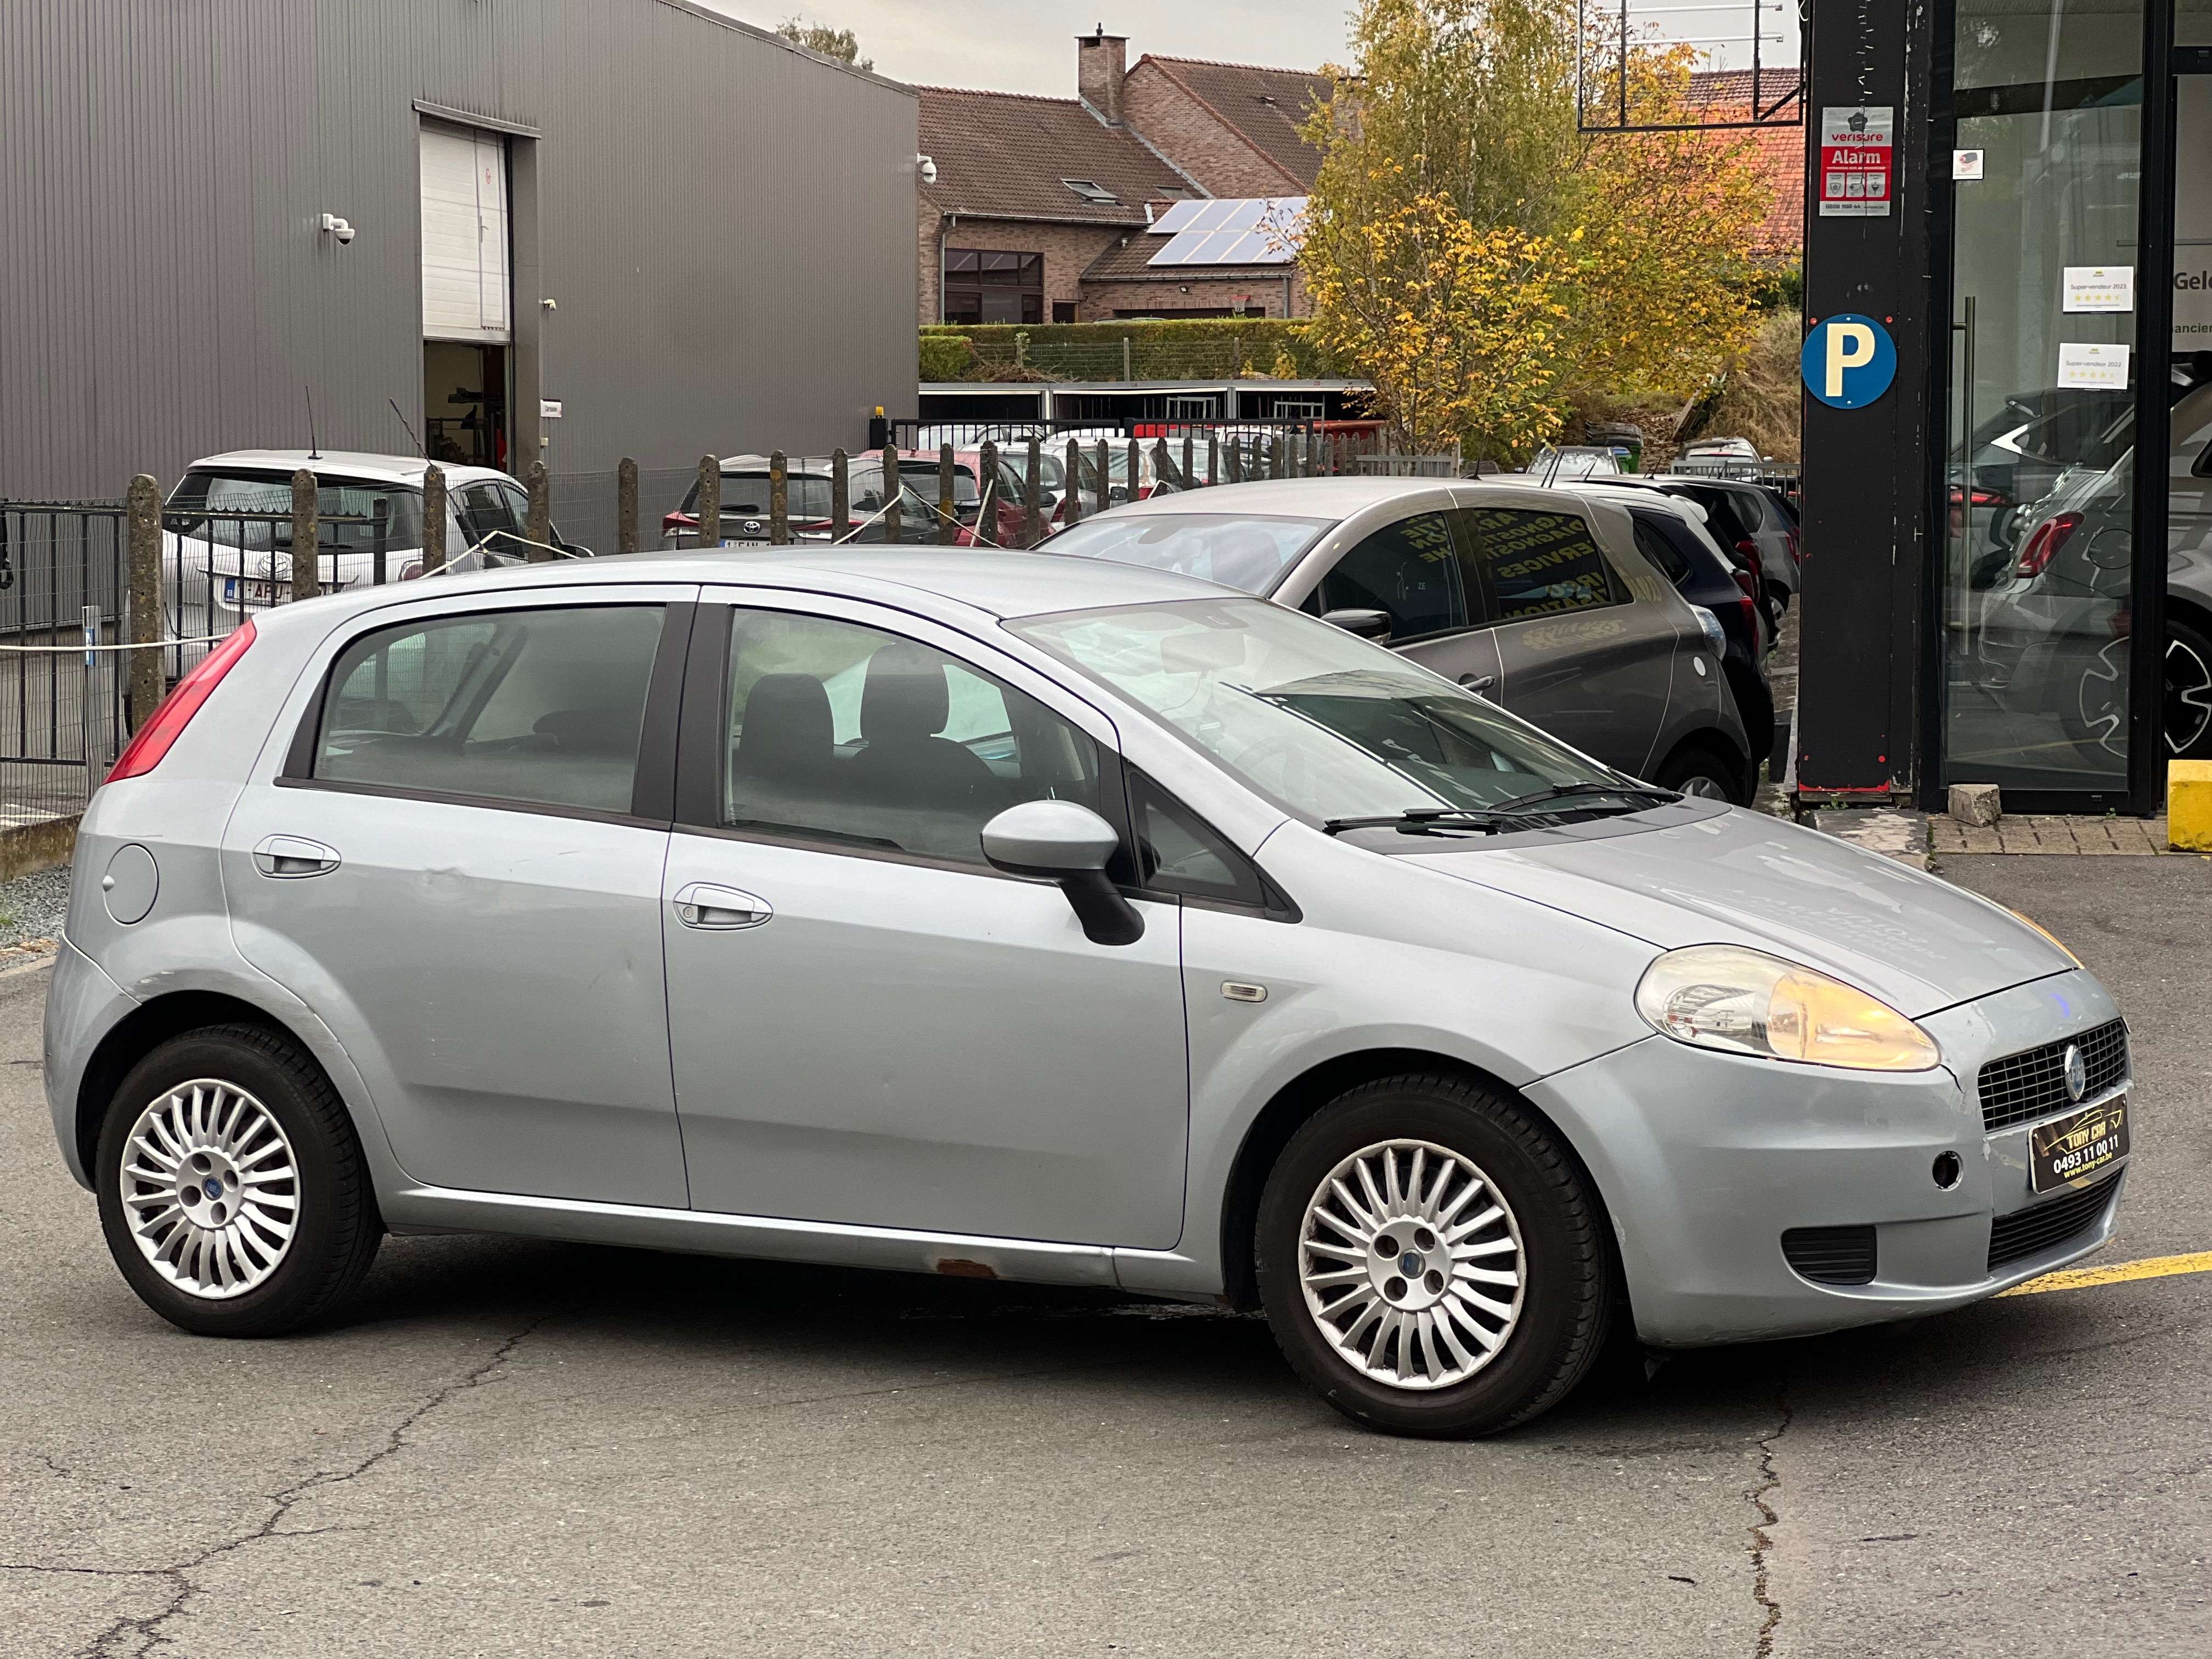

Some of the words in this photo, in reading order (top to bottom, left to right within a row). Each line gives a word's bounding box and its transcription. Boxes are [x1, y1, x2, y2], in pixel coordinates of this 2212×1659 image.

[1831, 133, 1883, 142] verisure
[1831, 149, 1881, 164] Alarm
[1825, 323, 1875, 397] P
[2066, 1128, 2090, 1149] TONY
[2091, 1121, 2106, 1140] CAR
[2053, 1152, 2081, 1174] 0493
[2084, 1147, 2095, 1162] 11
[2096, 1139, 2108, 1156] 00
[2108, 1134, 2118, 1150] 11
[2063, 1152, 2113, 1179] www.tony-car.be
